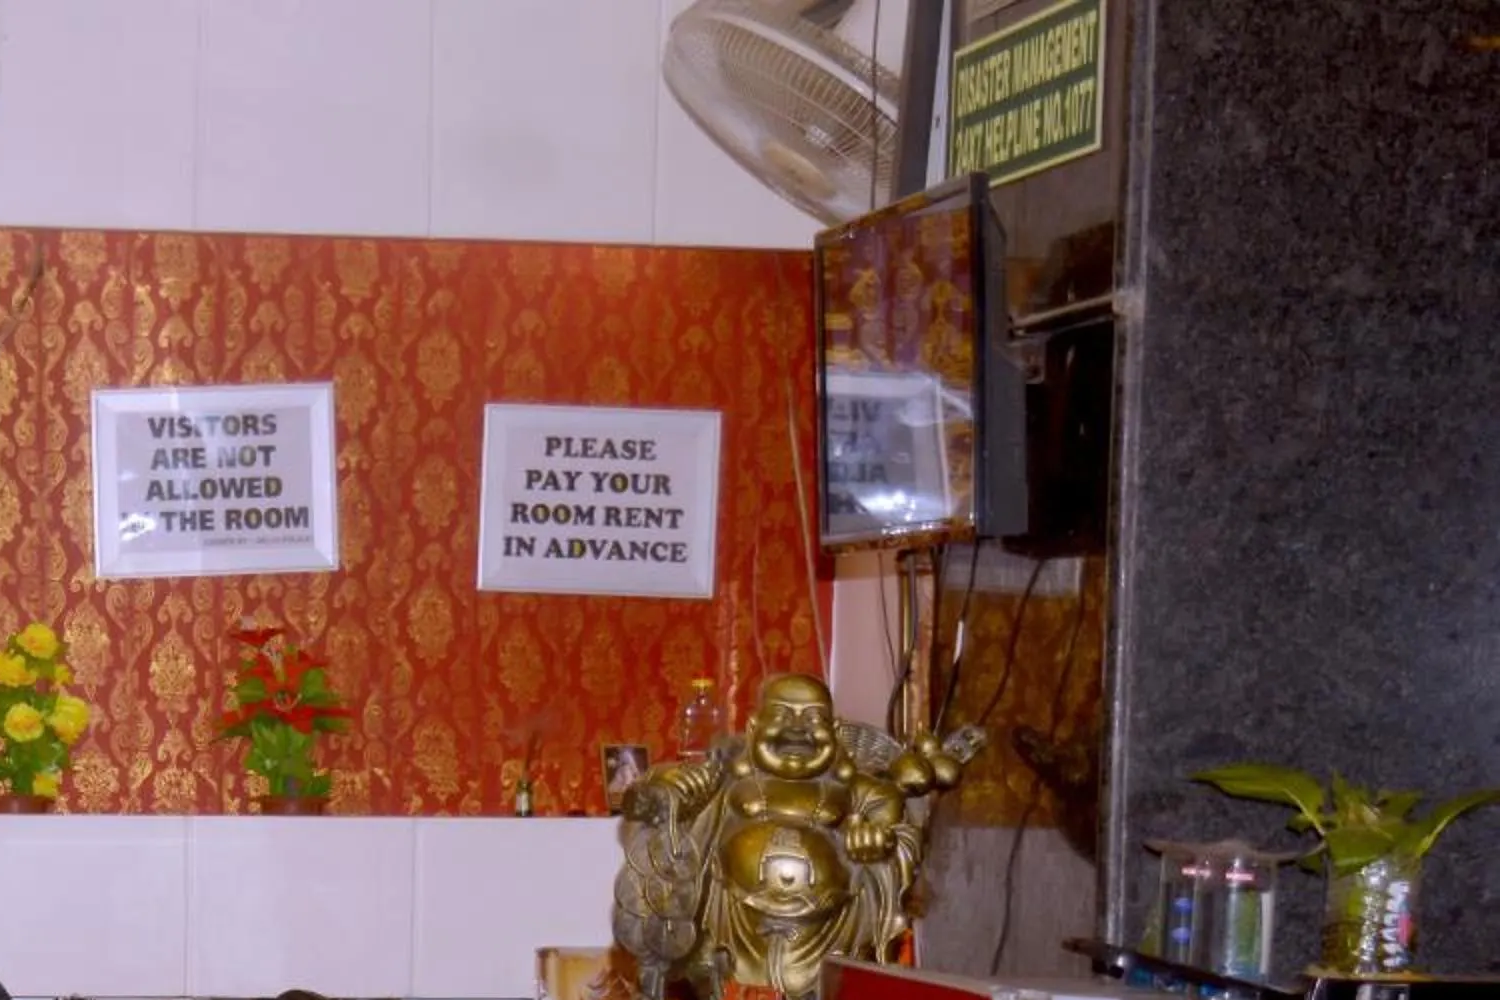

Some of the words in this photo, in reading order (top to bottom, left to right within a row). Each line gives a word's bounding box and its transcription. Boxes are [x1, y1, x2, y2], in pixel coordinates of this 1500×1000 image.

[956, 49, 1012, 119] DISASTER
[1012, 9, 1097, 94] MANAGEMENT
[984, 98, 1041, 168] HELPLINE
[1065, 76, 1095, 139] 1077
[150, 446, 207, 471] ARE
[216, 444, 277, 469] NOT
[543, 435, 658, 462] PLEASE
[144, 475, 284, 502] ALLOWED
[524, 468, 582, 493] PAY
[589, 470, 672, 497] YOUR
[158, 508, 216, 533] THE
[224, 506, 310, 532] ROOM
[509, 501, 596, 528] ROOM
[603, 505, 685, 531] RENT
[502, 535, 537, 559] IN
[543, 537, 689, 564] ADVANCE
